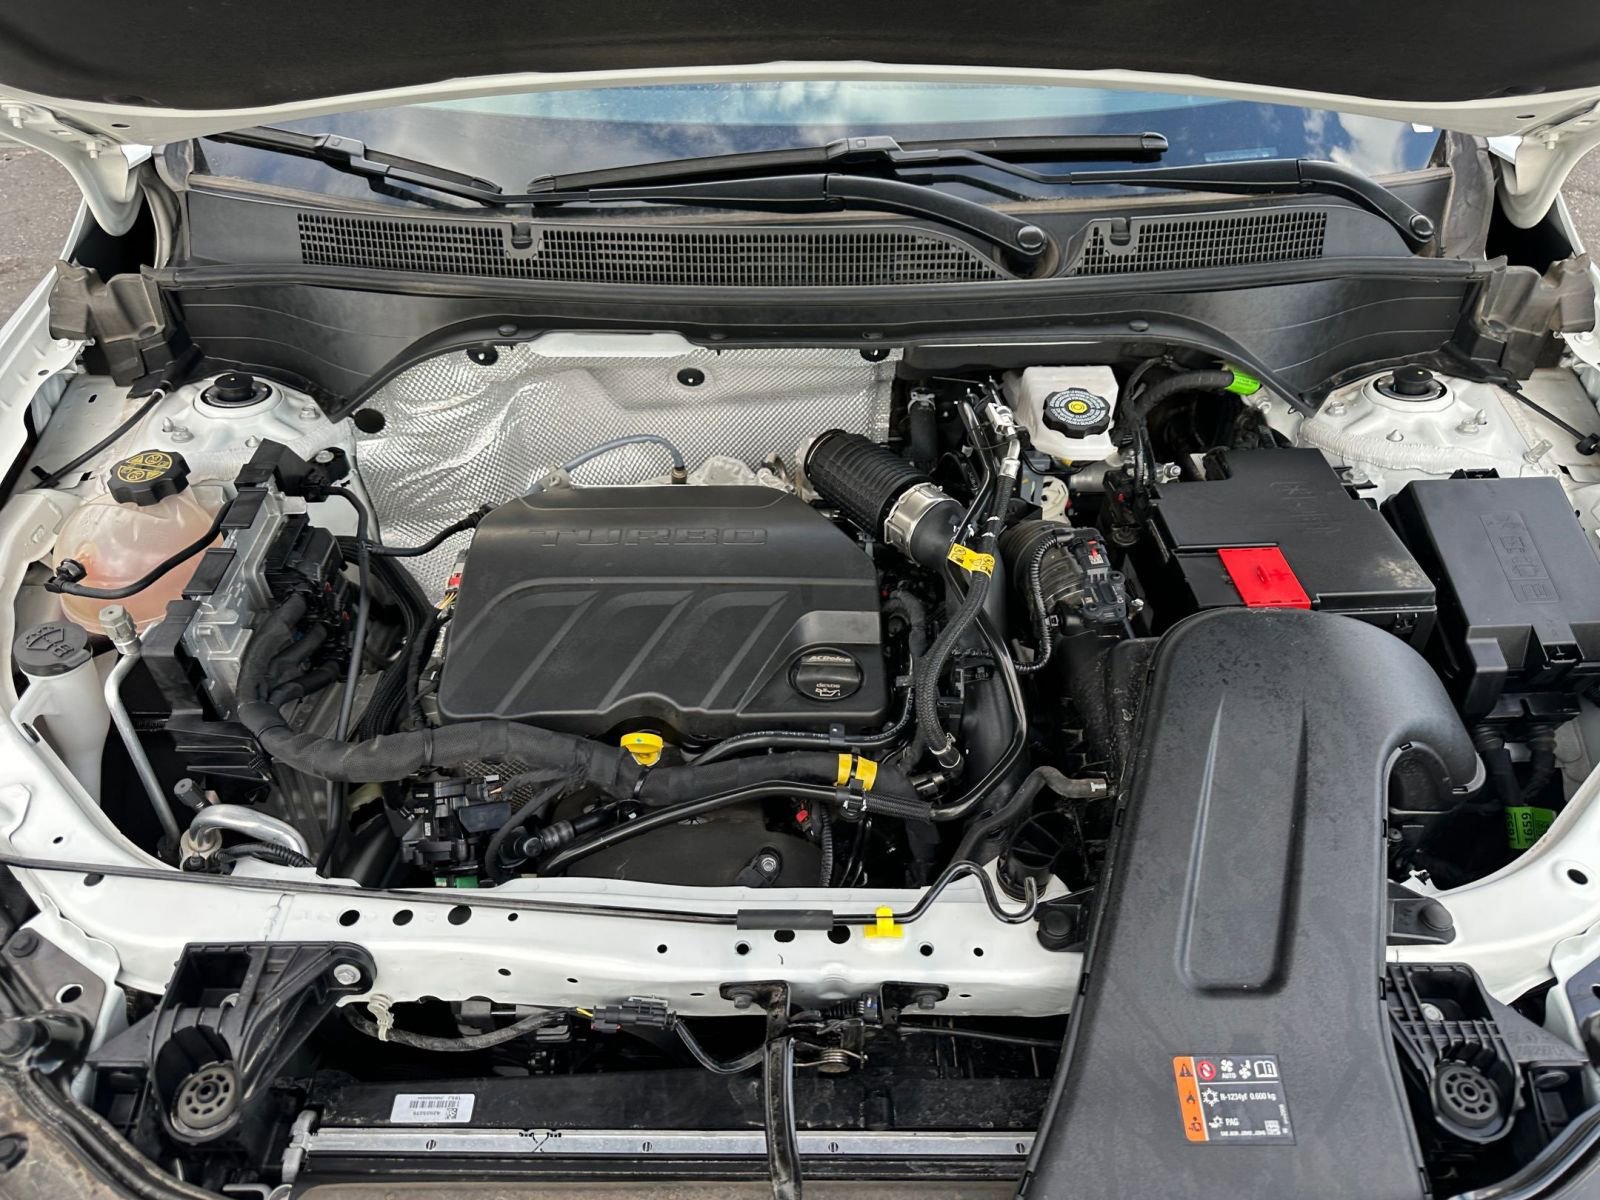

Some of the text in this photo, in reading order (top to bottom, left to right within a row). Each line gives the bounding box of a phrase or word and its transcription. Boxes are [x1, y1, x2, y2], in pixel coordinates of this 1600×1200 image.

[528, 528, 768, 547] TURBO
[1521, 812, 1533, 843] 1659
[1225, 1118, 1239, 1126] PAG
